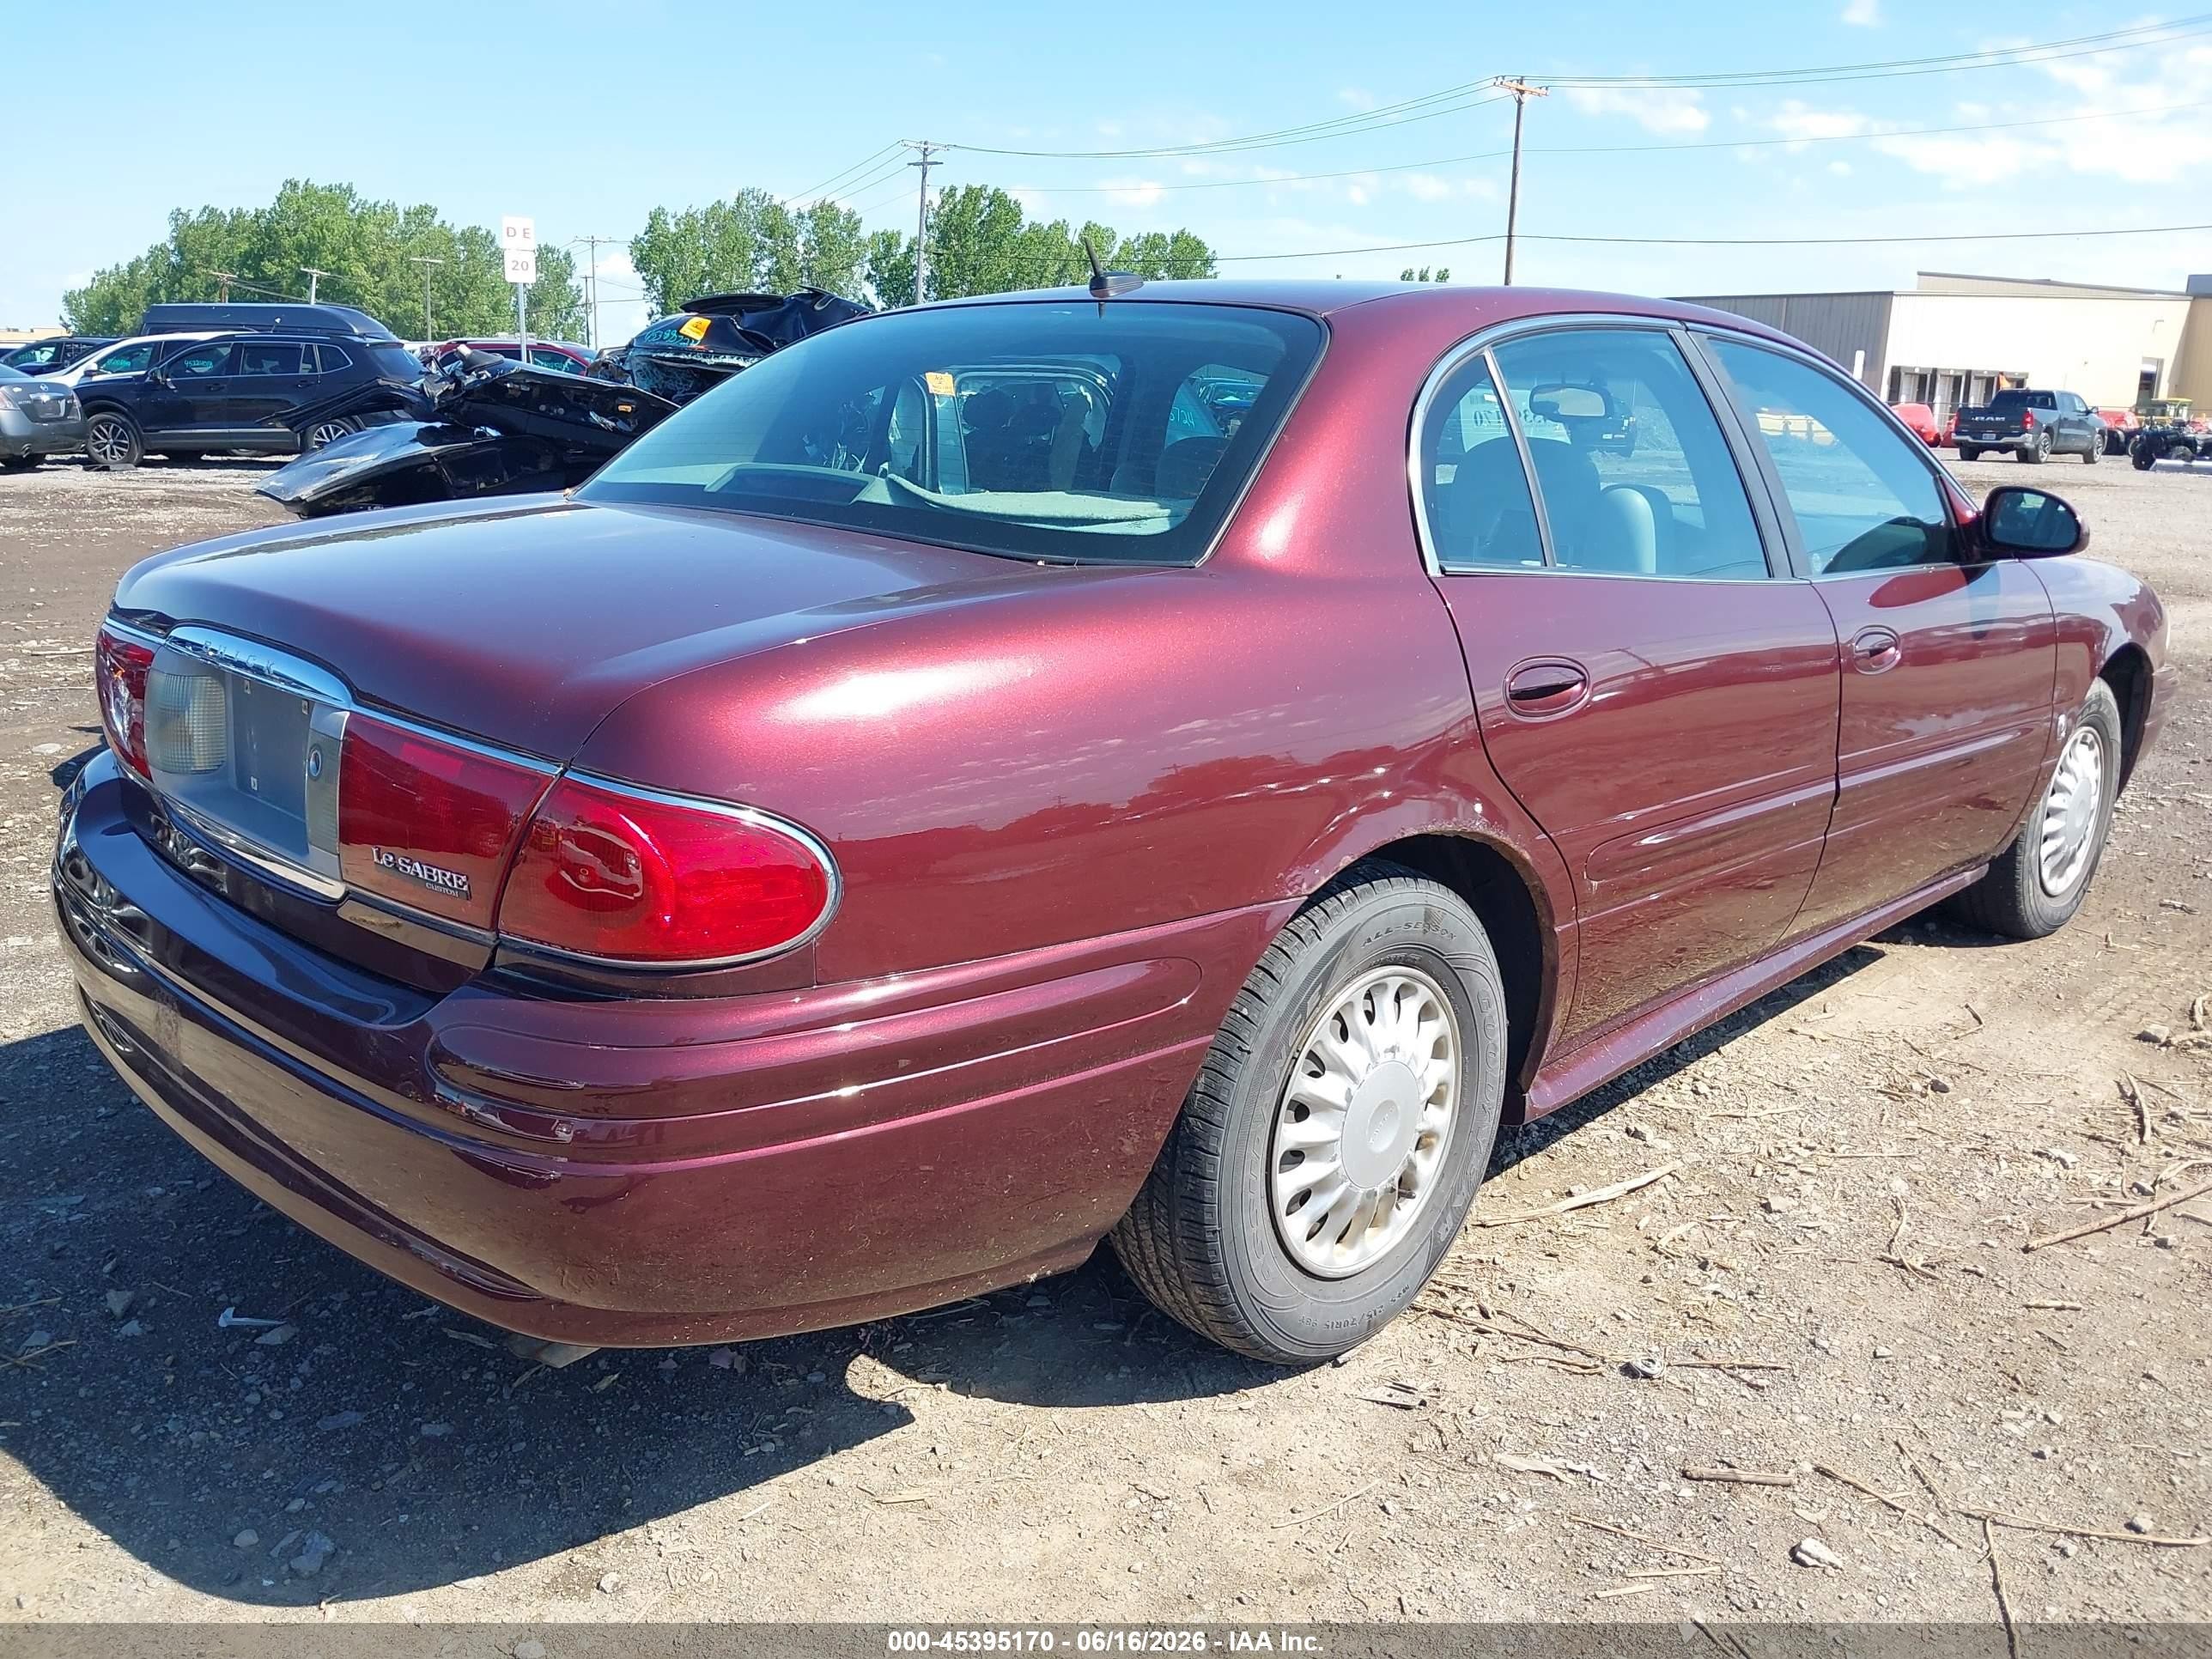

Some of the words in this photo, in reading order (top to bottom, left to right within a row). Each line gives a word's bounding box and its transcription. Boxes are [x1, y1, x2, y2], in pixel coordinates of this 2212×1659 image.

[506, 226, 517, 238] D
[522, 228, 531, 240] E
[511, 259, 529, 271] 20
[203, 640, 275, 674] BUICK
[425, 882, 459, 898] CUSTOM
